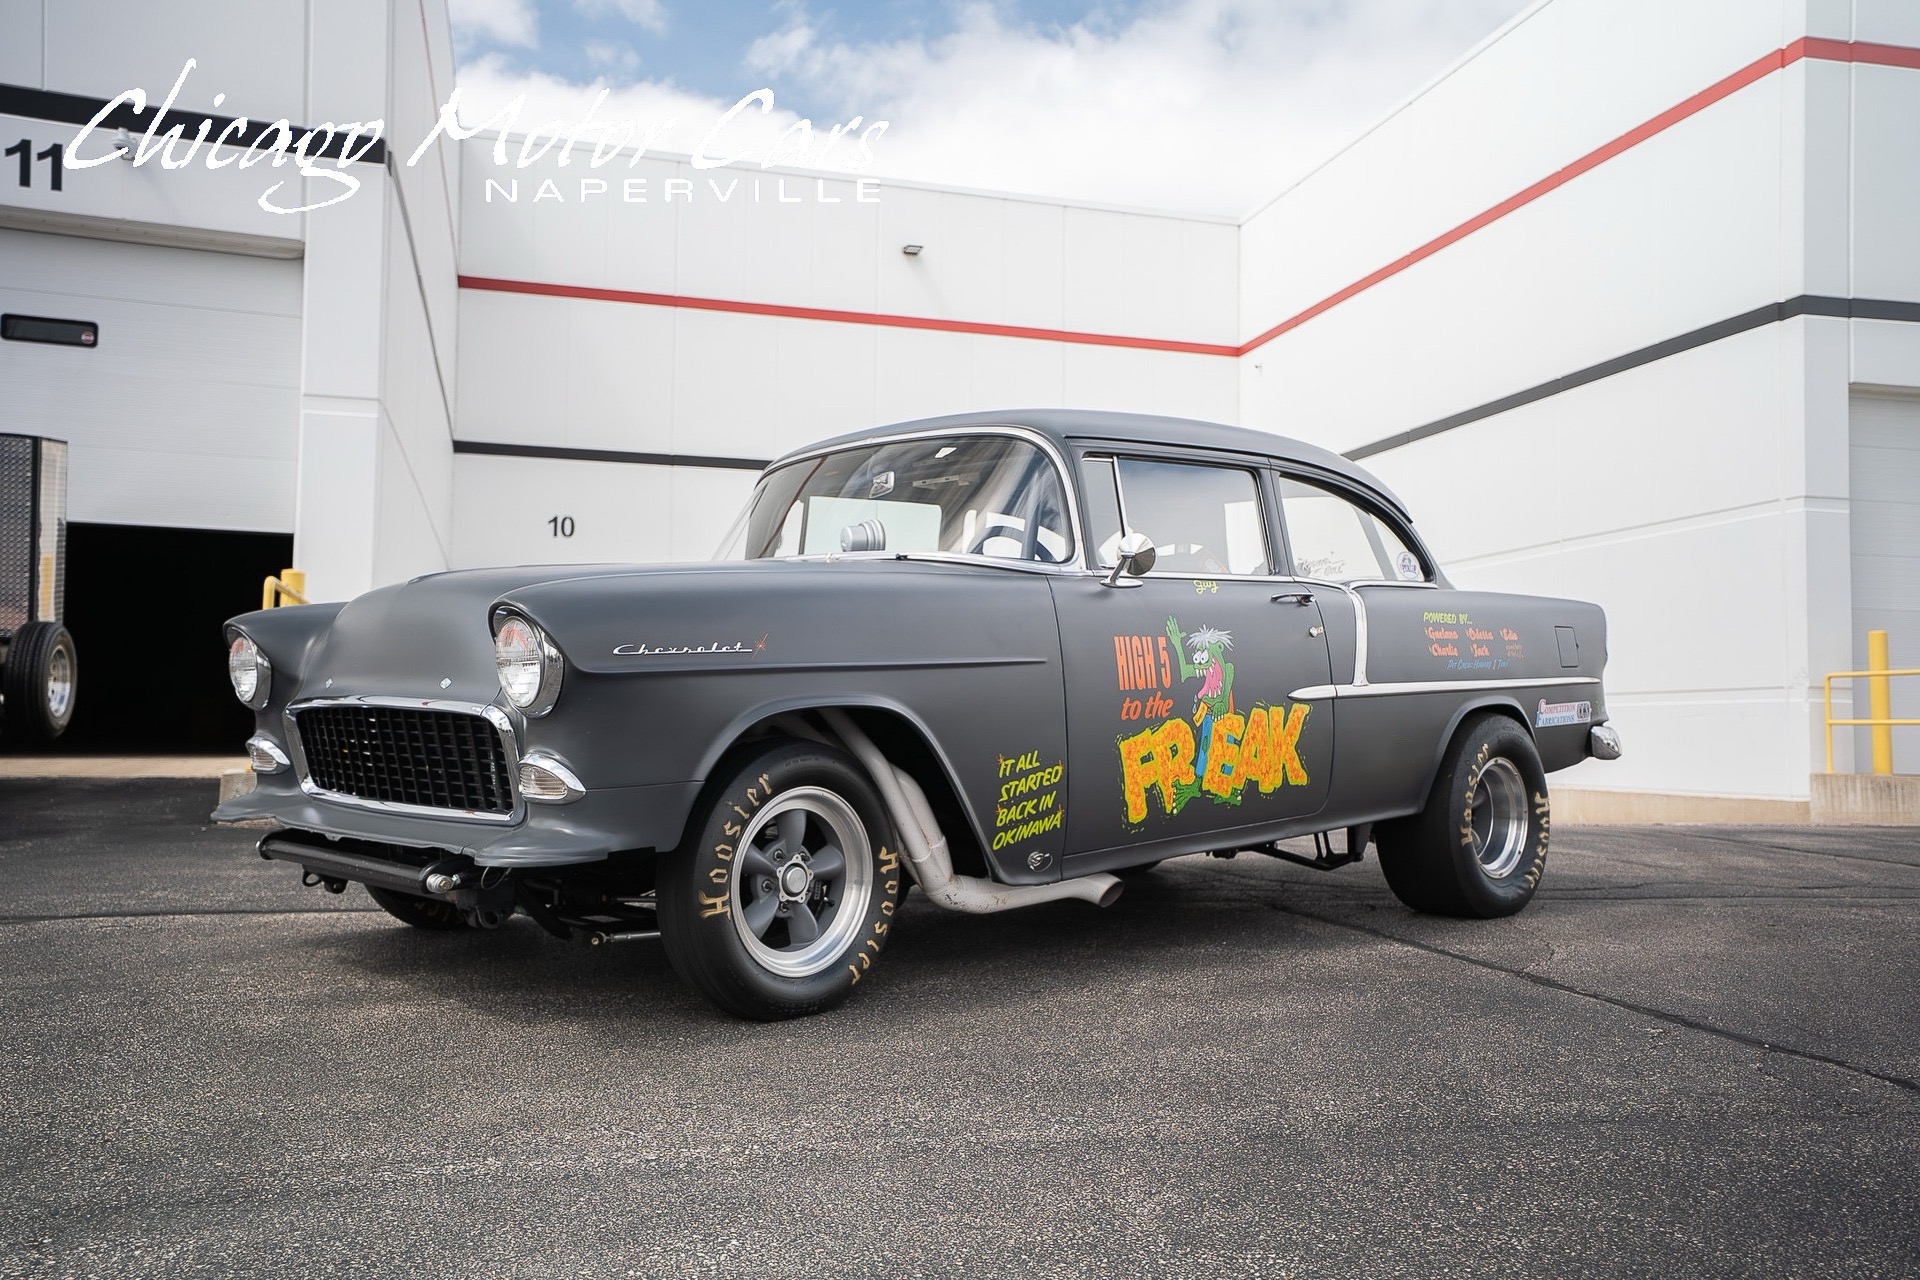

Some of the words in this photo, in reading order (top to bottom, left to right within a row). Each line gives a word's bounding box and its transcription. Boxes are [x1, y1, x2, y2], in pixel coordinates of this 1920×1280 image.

[4, 138, 63, 192] 11
[548, 516, 575, 537] 10
[1423, 611, 1457, 624] POWERED
[612, 641, 753, 656] Chevrolet
[1114, 635, 1157, 690] HIGH
[1157, 636, 1172, 689] 5
[1120, 697, 1141, 720] to
[1144, 691, 1173, 719] the
[998, 759, 1015, 778] IT
[1016, 750, 1040, 773] ALL
[1119, 702, 1311, 824] FREAK
[998, 765, 1062, 802] STARTED
[996, 798, 1037, 827] BACK
[1039, 790, 1056, 812] IN
[699, 773, 772, 921] Hoosier
[992, 812, 1061, 851] OKINAWA
[848, 846, 899, 985] Hoosier
